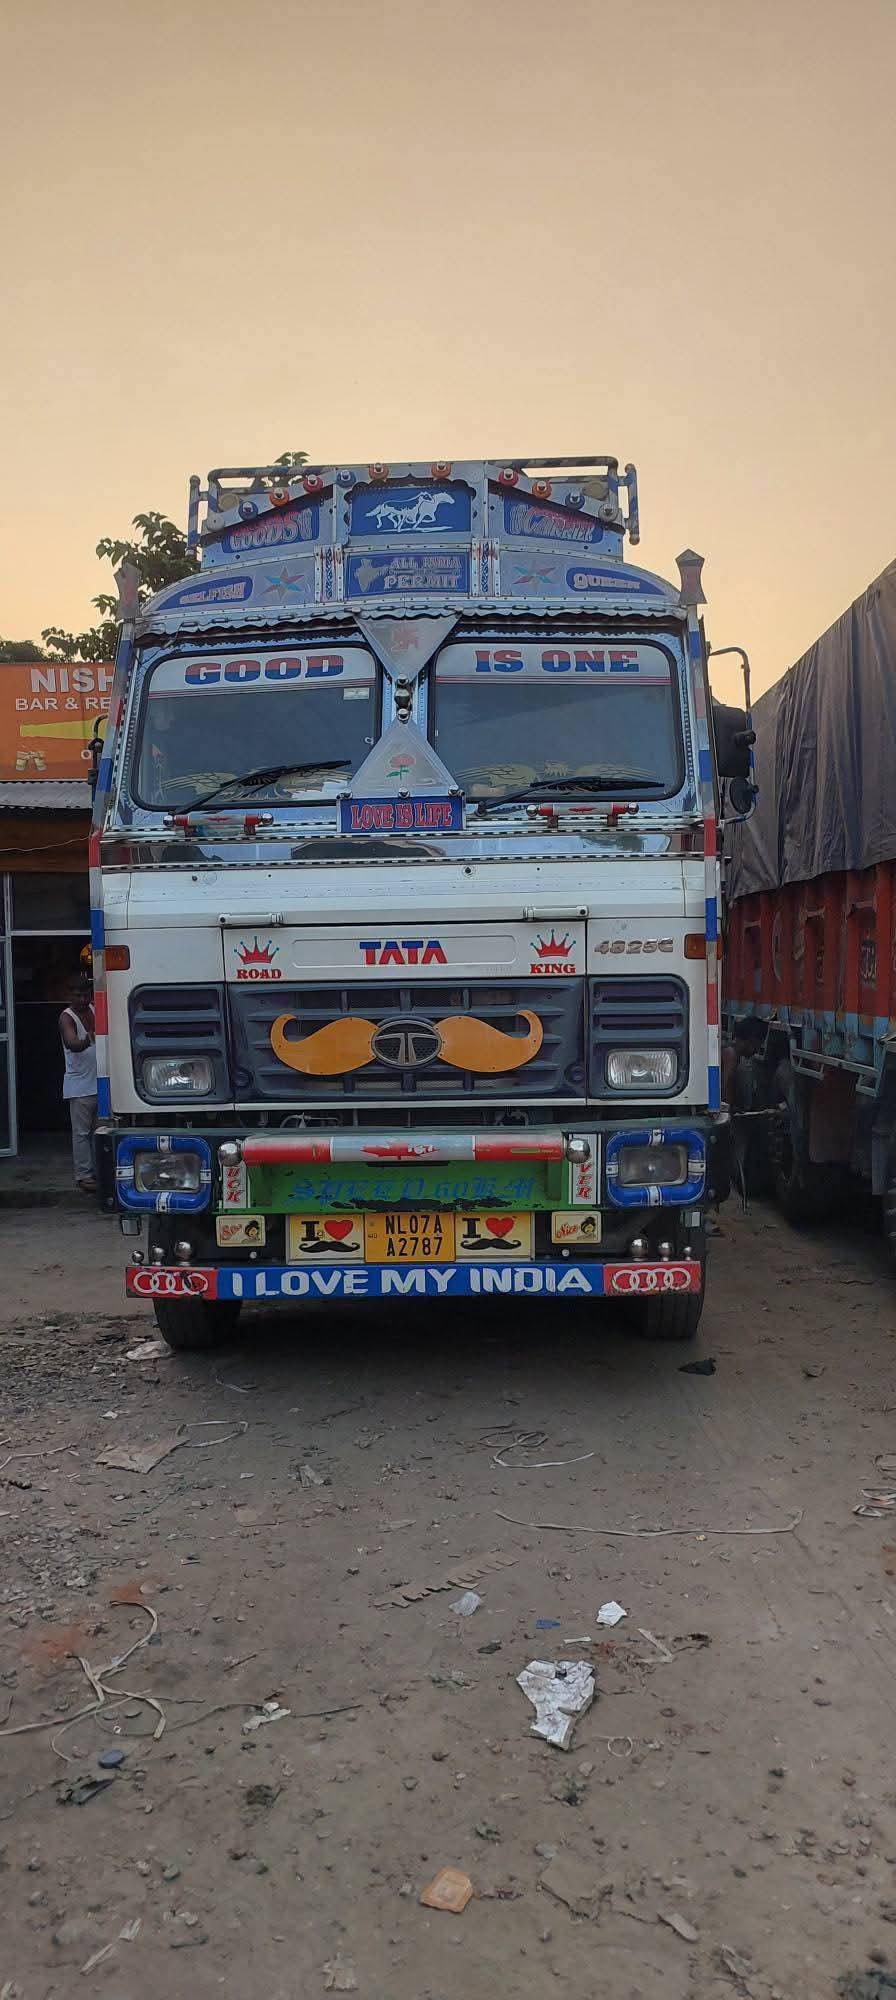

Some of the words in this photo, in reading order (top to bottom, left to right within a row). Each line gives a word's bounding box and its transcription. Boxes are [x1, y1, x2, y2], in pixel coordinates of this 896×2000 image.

[389, 557, 418, 570] ALL
[384, 575, 460, 589] PERMIT
[184, 654, 344, 685] GOOD
[475, 650, 524, 673] IS
[541, 650, 640, 673] ONE
[15, 698, 59, 711] BAR
[64, 697, 80, 710] &
[85, 697, 112, 710] RE
[351, 804, 394, 829] LOVE
[395, 803, 414, 828] IS
[414, 803, 453, 827] LIFE
[359, 940, 448, 965] TATA
[236, 968, 282, 980] ROAD
[530, 963, 577, 974] KING
[301, 1220, 320, 1242] I
[385, 1215, 443, 1235] NL07A
[462, 1217, 481, 1239] I
[386, 1236, 443, 1257] A2787
[232, 1272, 243, 1297] I
[256, 1270, 369, 1296] LOVE
[381, 1267, 457, 1294] MY
[469, 1266, 593, 1293] INDIA
